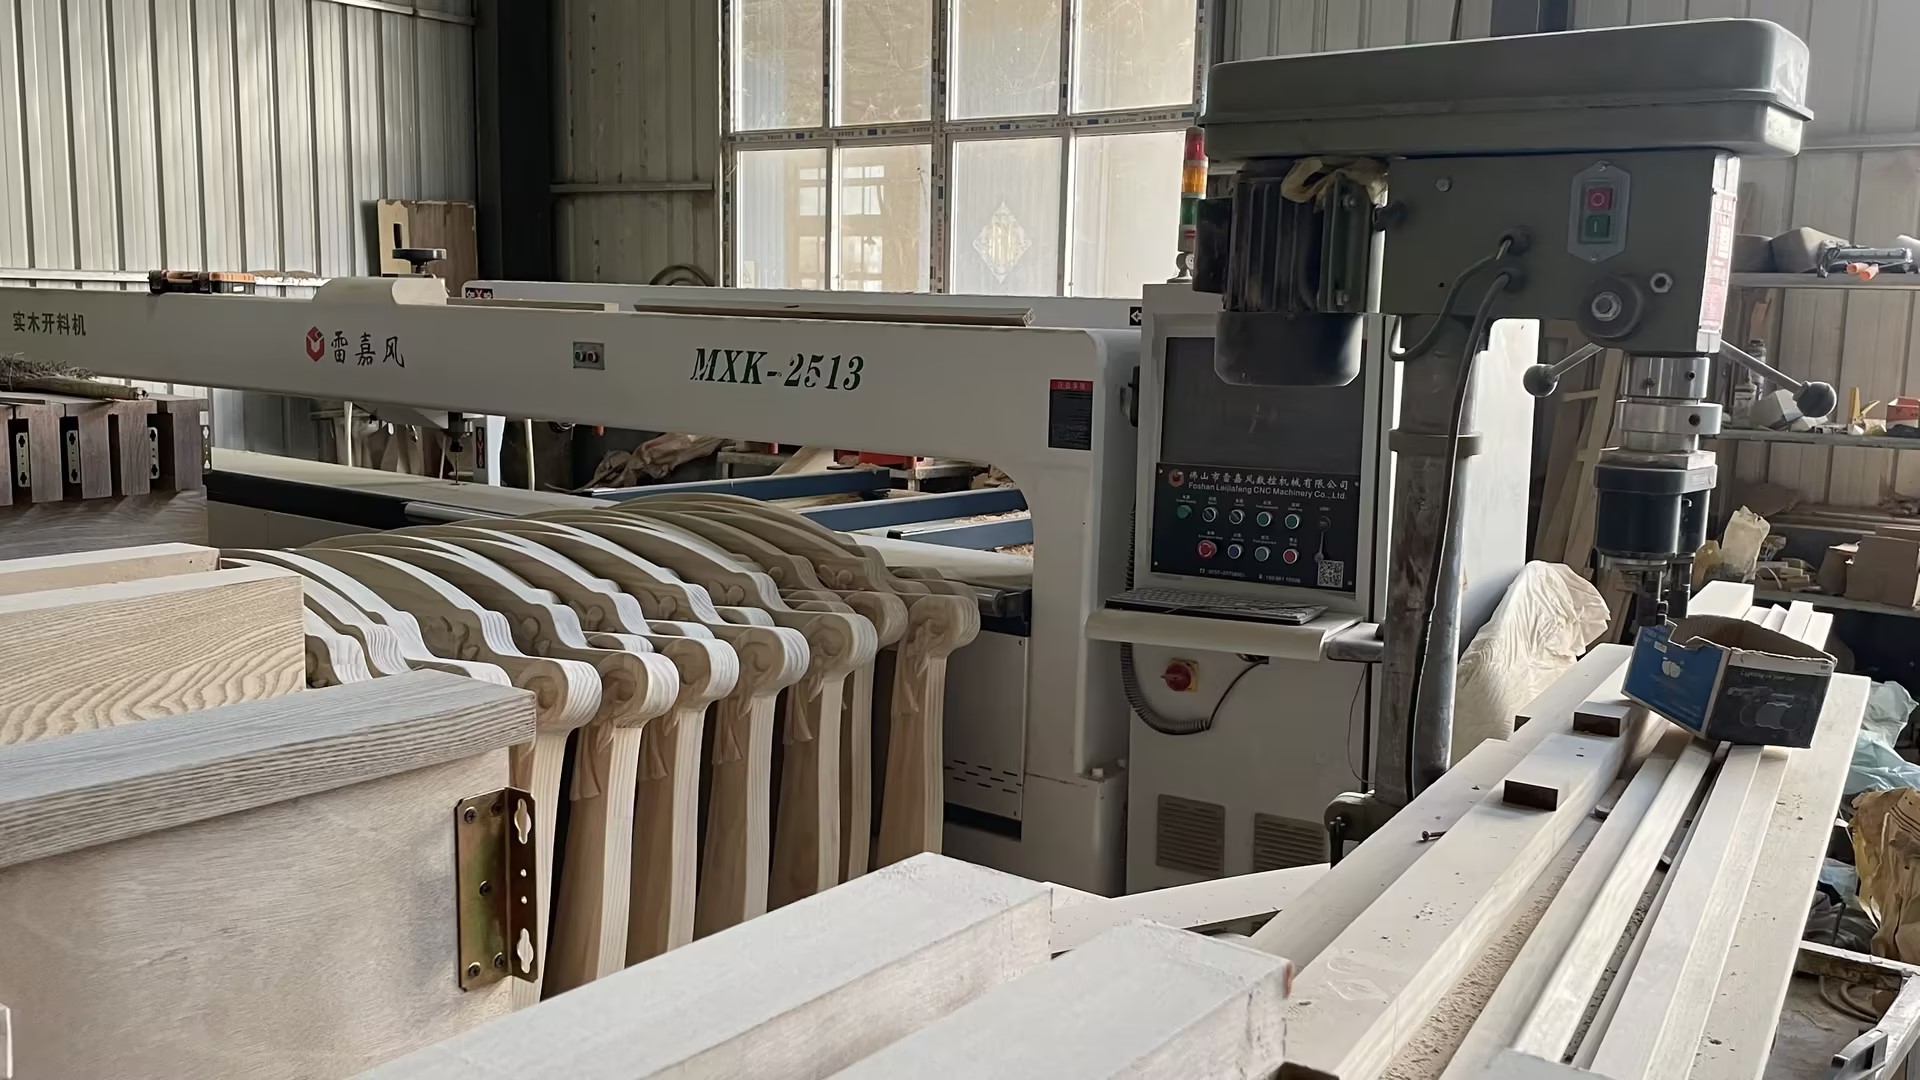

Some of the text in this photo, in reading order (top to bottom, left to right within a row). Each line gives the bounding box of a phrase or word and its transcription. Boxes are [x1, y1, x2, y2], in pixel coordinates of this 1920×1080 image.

[12, 310, 87, 336] 实木开料机
[331, 330, 405, 368] 雷嘉风
[690, 348, 865, 391] MXK-2513
[1188, 470, 1349, 491] 佛山市雷嘉风数控机械有限公司
[1188, 482, 1215, 491] Foshan
[1216, 484, 1252, 495] Leijiafeng
[1253, 487, 1272, 495] CNC
[1272, 487, 1313, 500] Machinery
